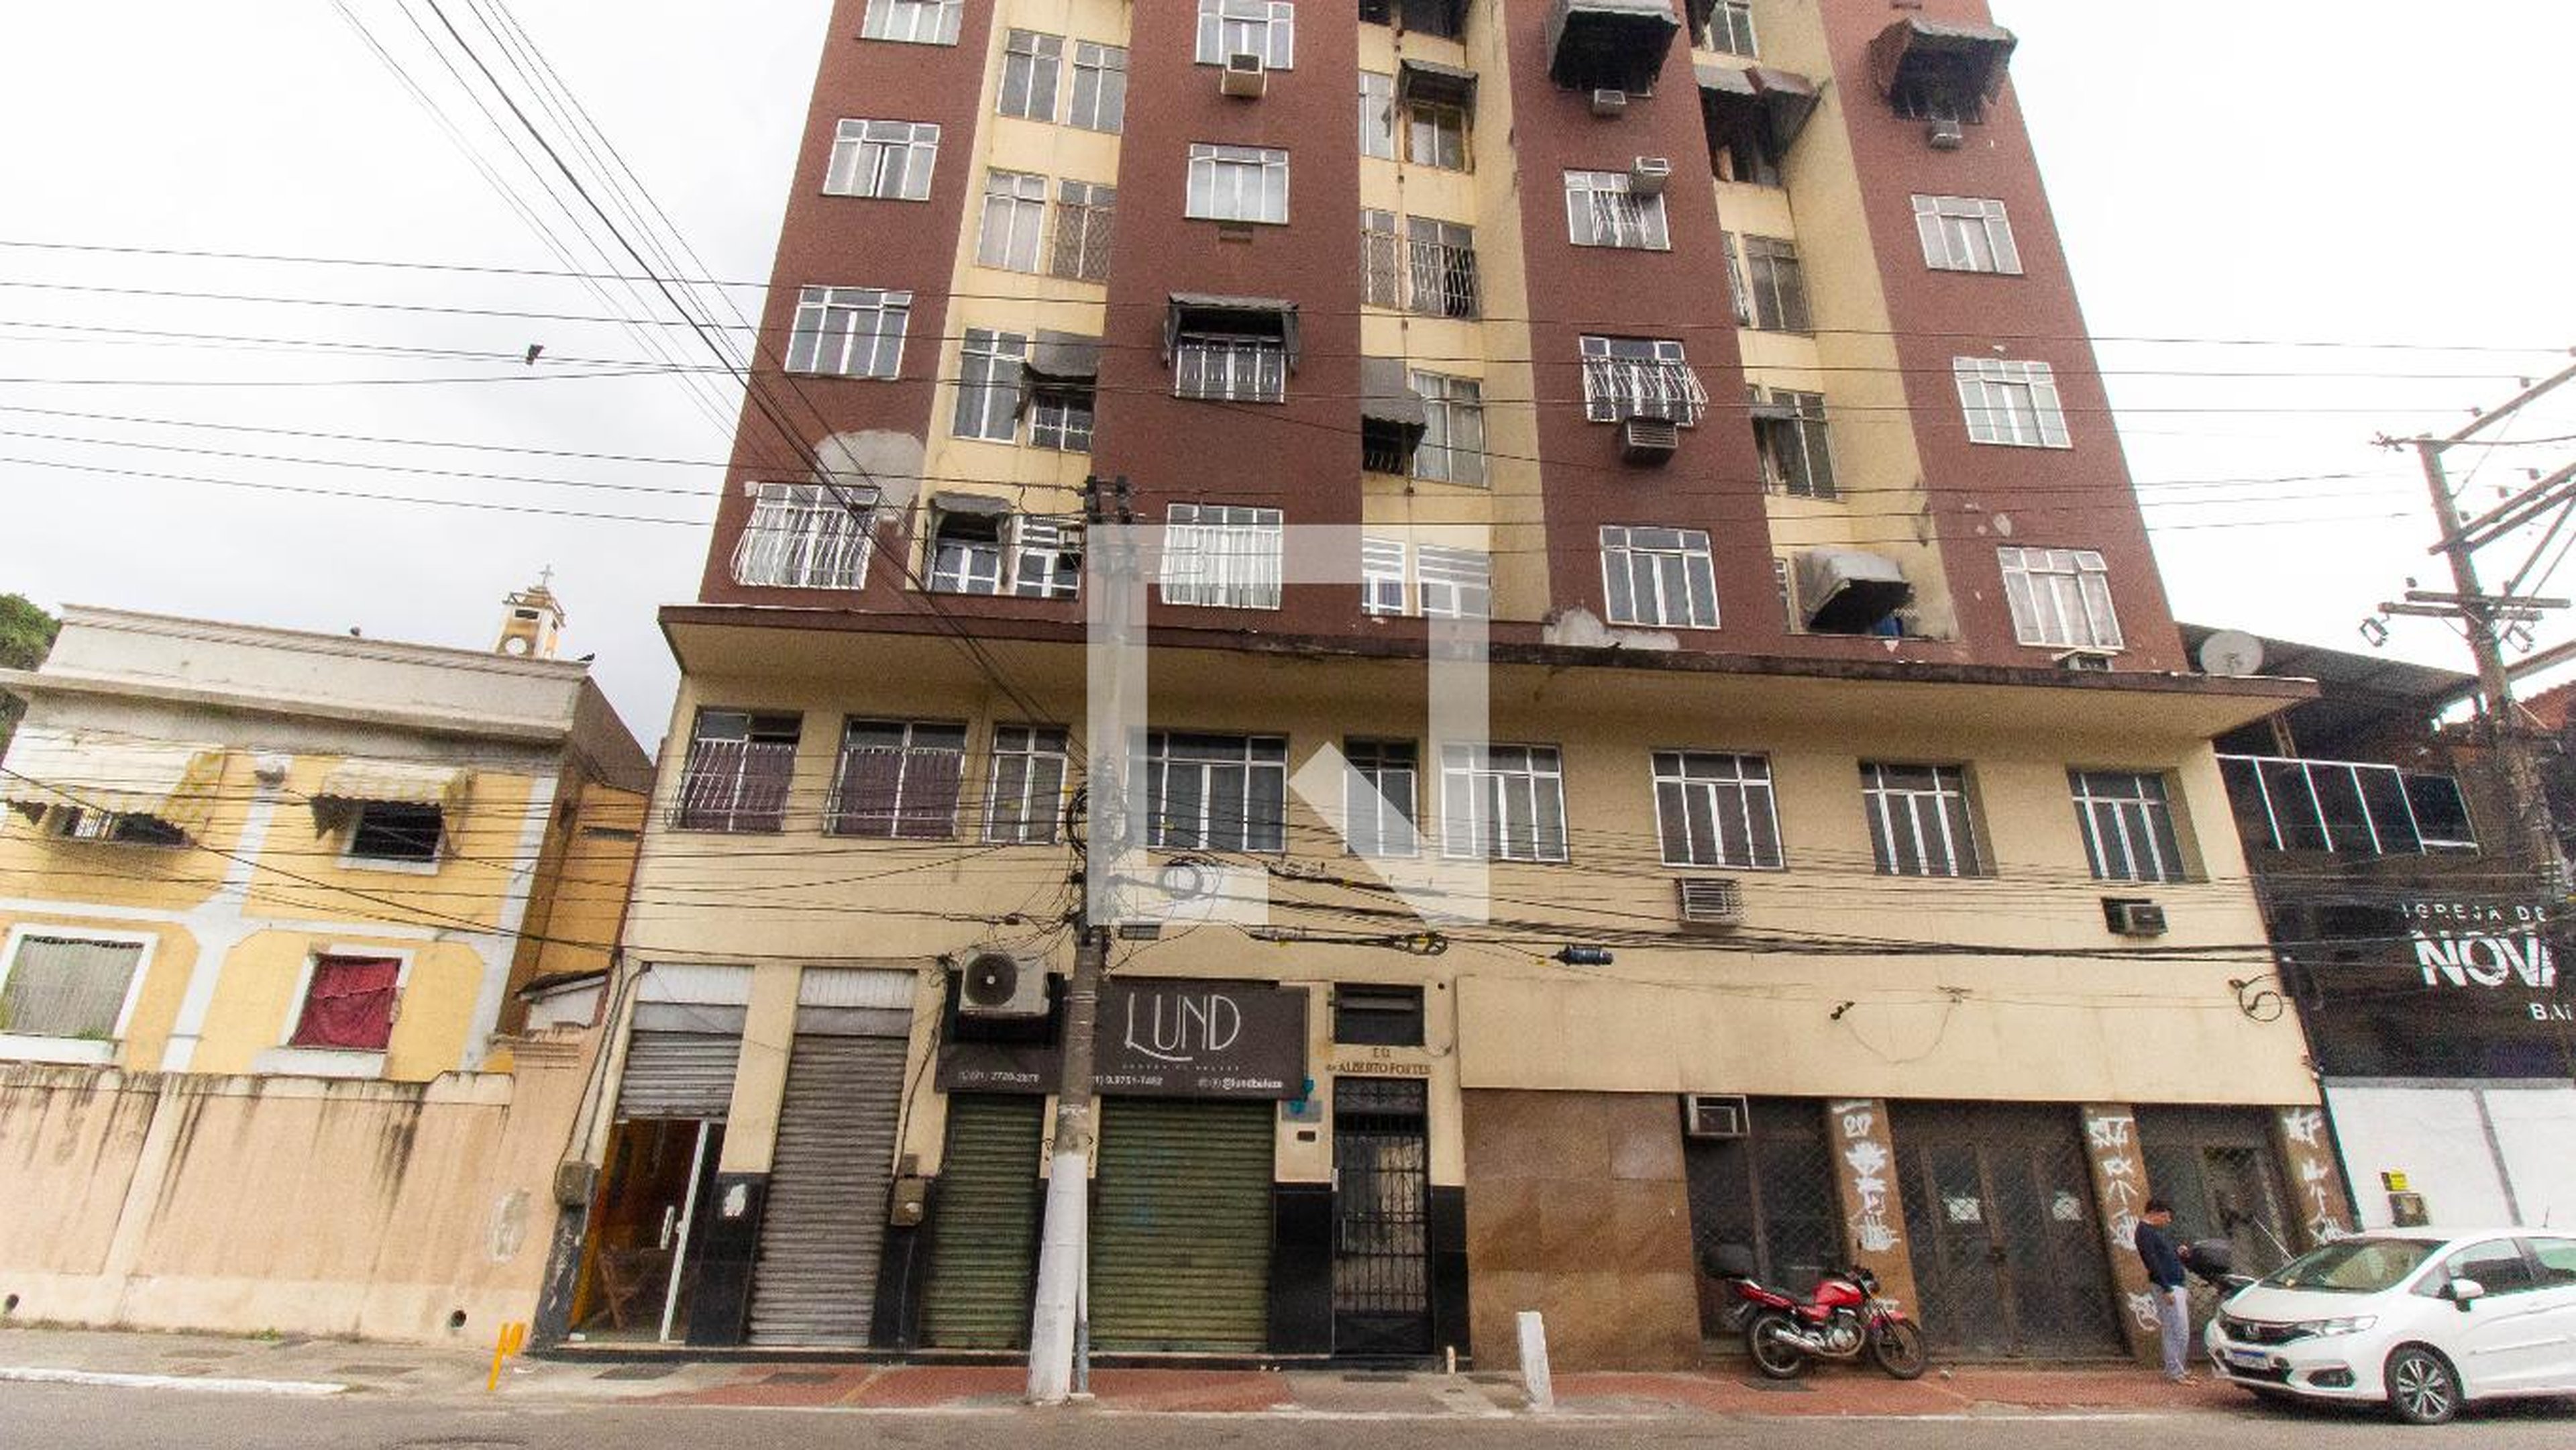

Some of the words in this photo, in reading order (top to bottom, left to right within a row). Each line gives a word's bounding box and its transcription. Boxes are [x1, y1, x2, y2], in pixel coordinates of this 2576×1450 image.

[2401, 903, 2502, 921] IGREJA
[2515, 905, 2547, 922] DE
[1124, 992, 1240, 1061] LUND
[1338, 1061, 1388, 1074] ALBERTO
